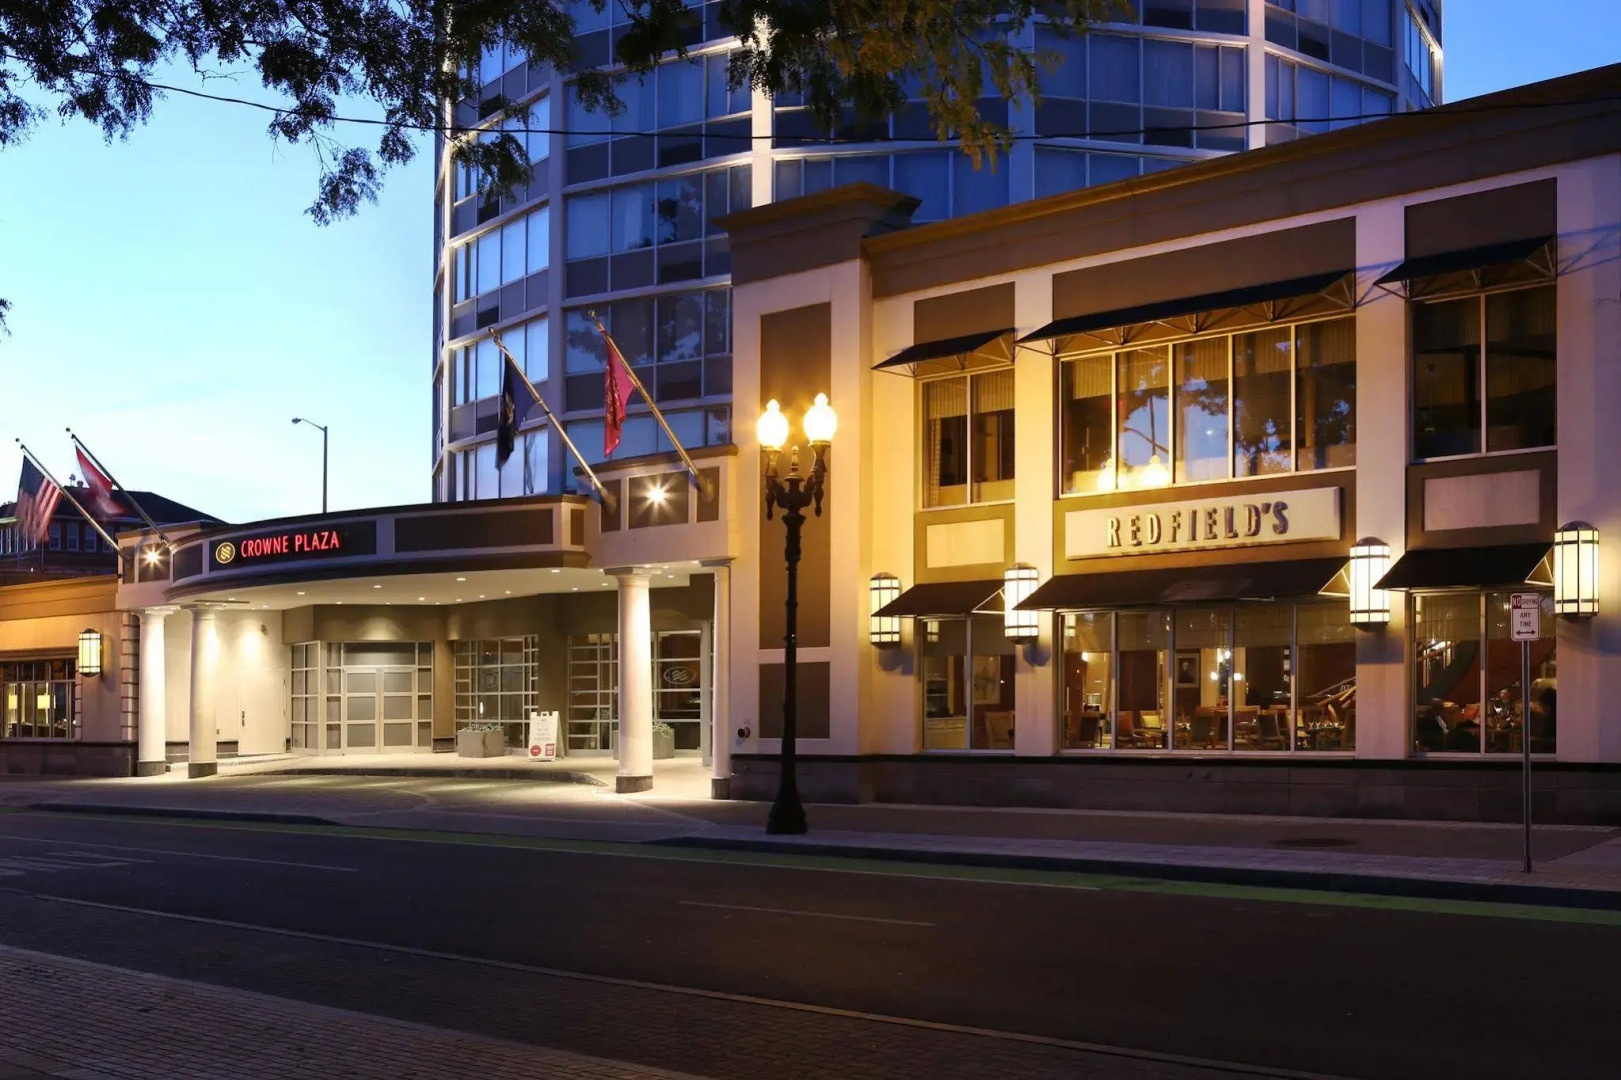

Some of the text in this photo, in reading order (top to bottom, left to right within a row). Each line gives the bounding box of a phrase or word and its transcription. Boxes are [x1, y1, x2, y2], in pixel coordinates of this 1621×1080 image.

[1106, 501, 1289, 548] REDFIELD'S
[241, 531, 340, 558] CROWNE PLAZA
[1512, 596, 1521, 606] NO
[1519, 620, 1532, 628] TIME
